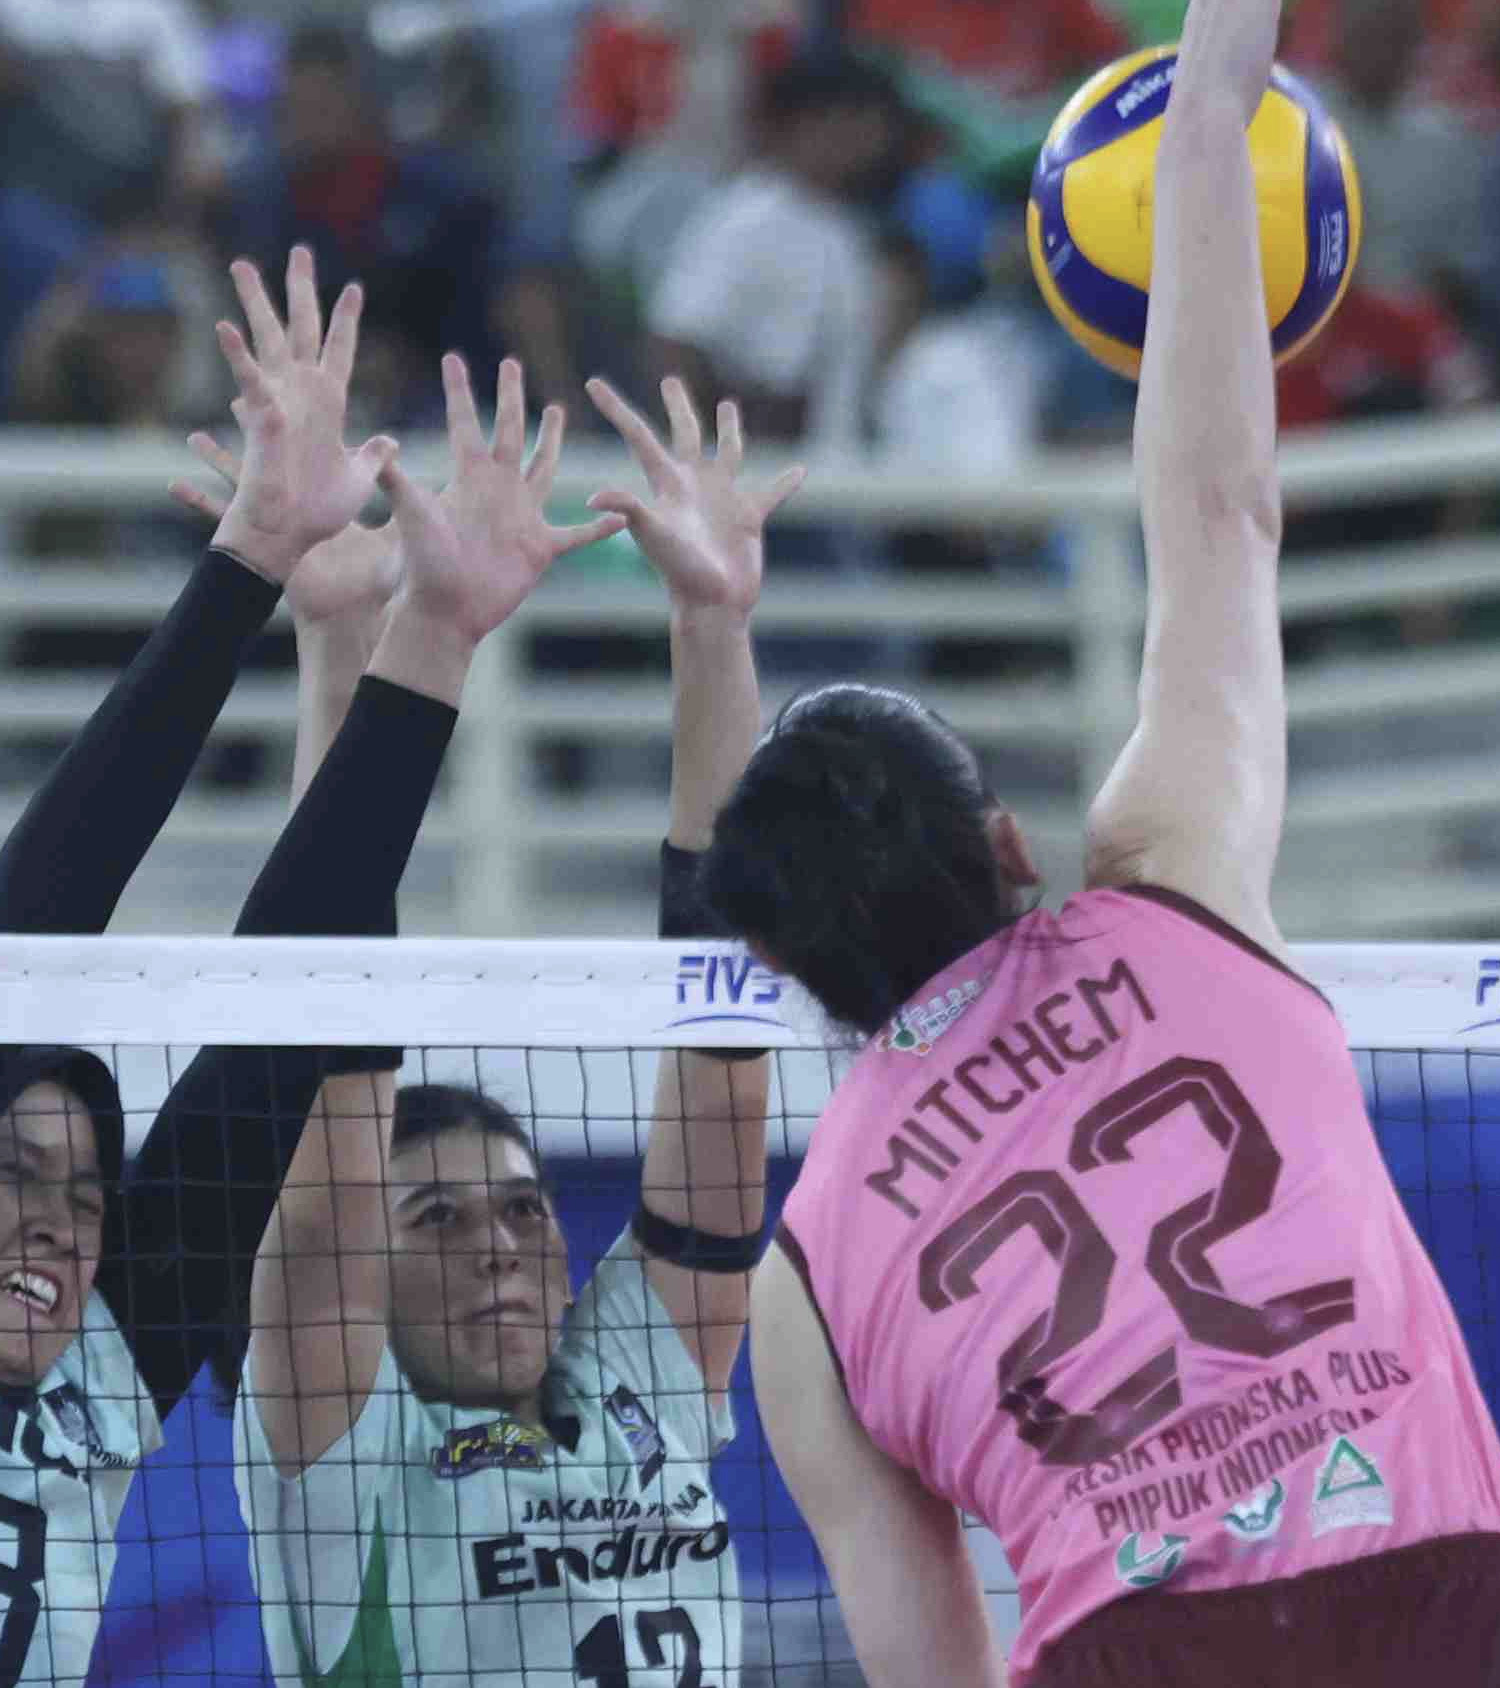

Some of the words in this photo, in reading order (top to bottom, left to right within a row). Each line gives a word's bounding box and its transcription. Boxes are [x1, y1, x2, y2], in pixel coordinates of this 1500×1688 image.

[864, 957, 1158, 1220] MITCHEM
[917, 1055, 1356, 1467] 22
[1160, 1368, 1320, 1463] PHONSKA
[1327, 1348, 1413, 1397] PLUS
[1216, 1407, 1382, 1499] INDONESIA
[472, 1521, 729, 1600] Enduro
[520, 1496, 644, 1524] JAKARTA
